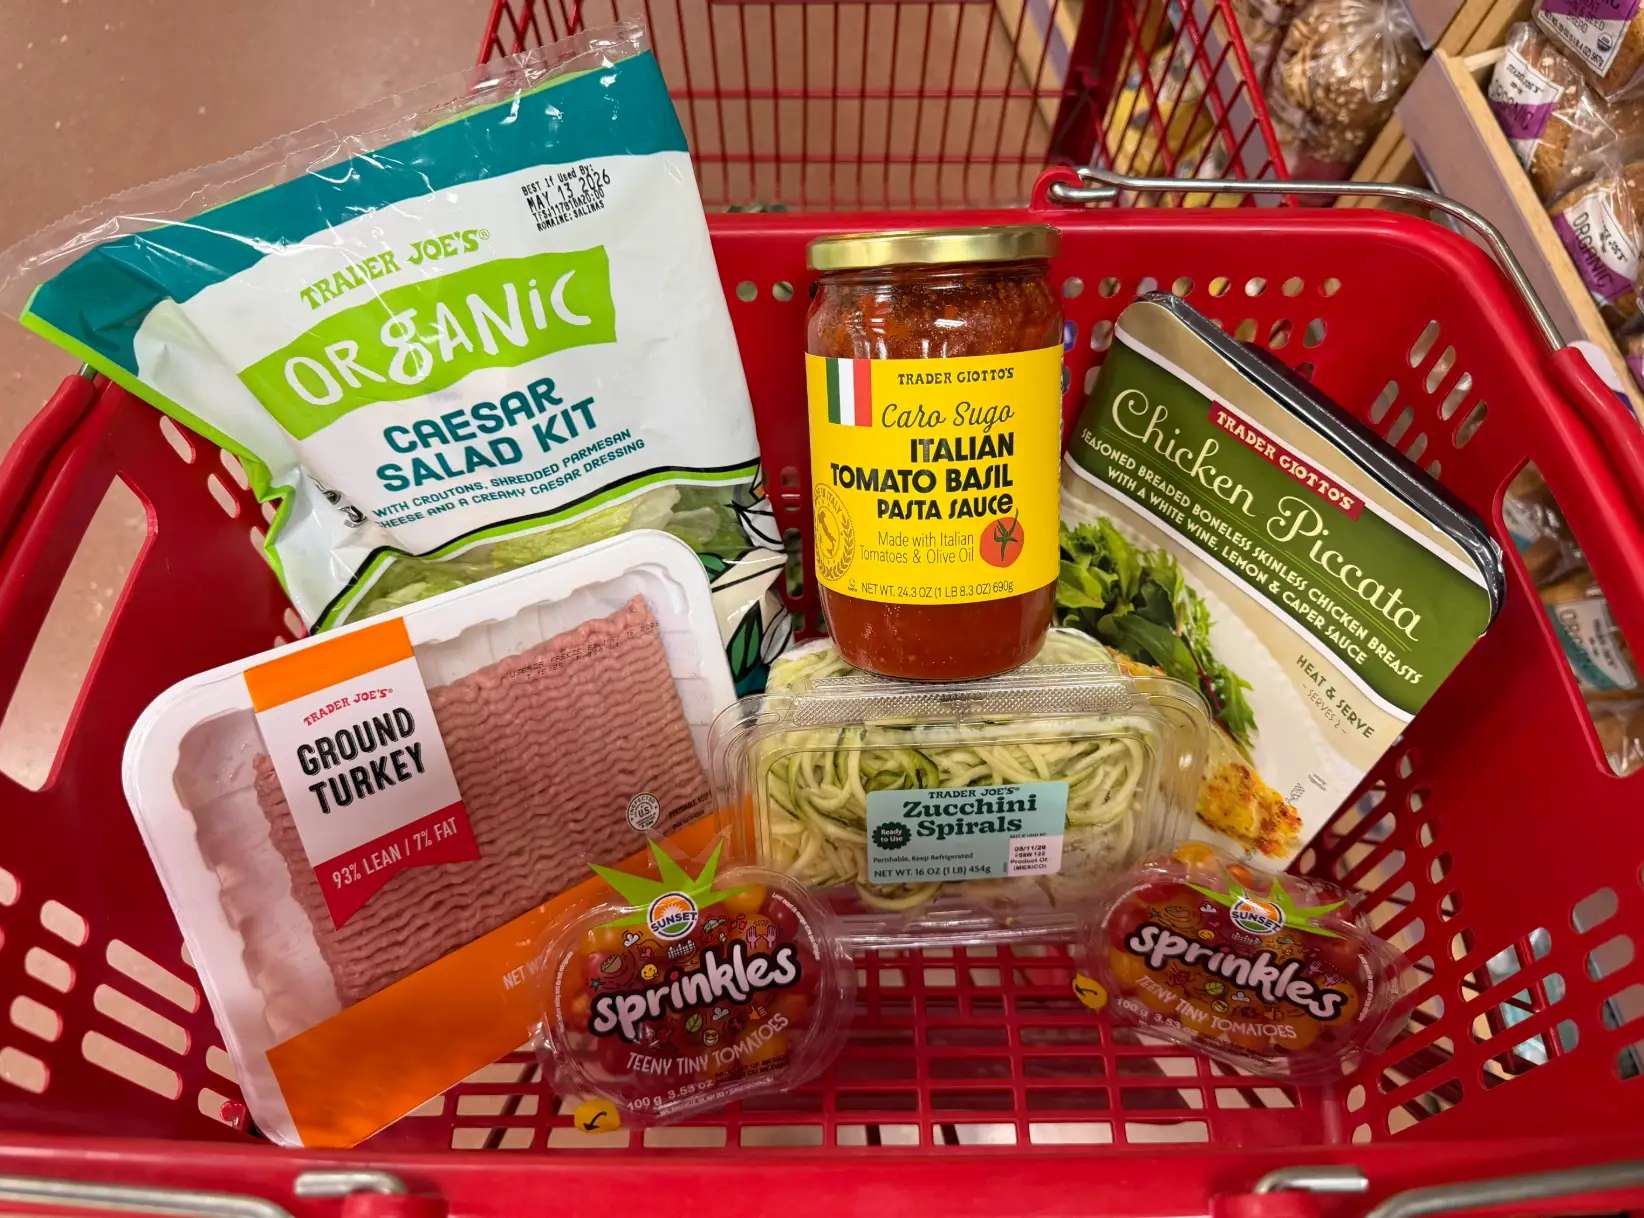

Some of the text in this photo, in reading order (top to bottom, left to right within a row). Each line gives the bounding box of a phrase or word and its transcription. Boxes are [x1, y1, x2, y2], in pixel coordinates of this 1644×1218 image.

[521, 164, 594, 196] BEST If Used By:
[526, 168, 611, 213] MAY 13 2026
[1573, 211, 1612, 288] ORGANIC
[299, 250, 402, 310] TRADER
[898, 367, 1014, 386] TRADER GIOTTO'S
[382, 376, 564, 454] CAESAR
[881, 401, 1015, 434] Caro Sugo
[376, 396, 599, 492] SALAD KIT
[910, 431, 1014, 463] ITALIAN
[1215, 409, 1356, 512] TRADER GIOTTO'S
[372, 500, 410, 518] WITH
[412, 480, 489, 507] CROUTONS,
[490, 462, 560, 488] SHREDDED
[562, 428, 632, 467] PARMESAN
[427, 502, 456, 518] AND
[460, 498, 470, 509] A
[472, 487, 527, 504] CREAMY
[530, 470, 582, 496] CAESAR
[584, 438, 646, 473] DRESSING
[830, 462, 1014, 494] TOMATO BASIL
[877, 498, 942, 520] PASTA
[1110, 388, 1422, 642] Chicken Piccata
[860, 544, 974, 564] Tomatoes & Olive Oil
[878, 530, 974, 547] Made with Italian
[1080, 427, 1424, 685] SEASONED BREADED BONELESS SKINLESS CHICKEN BREASTS
[1108, 466, 1369, 666] WITH A WHITE WINE, LEMON & CAPER SAUCE
[861, 582, 878, 596] NET
[879, 584, 896, 597] WT.
[897, 586, 917, 598] 24.3
[919, 587, 932, 598] OZ
[934, 586, 942, 600] (1
[944, 586, 958, 598] LB
[960, 585, 974, 597] 8.3
[976, 583, 991, 596] OZ)
[992, 580, 1014, 594] 690g
[303, 697, 350, 727] TRADER
[1296, 654, 1375, 739] HEAT & SERVE
[1306, 689, 1341, 729] SERVES 2
[296, 706, 416, 776] GROUND
[308, 742, 426, 814] TURKEY
[928, 789, 976, 799] TRADER
[902, 794, 1038, 818] Zucchini
[880, 828, 902, 836] Ready
[916, 816, 1022, 840] Spirals
[332, 862, 362, 890] 93%
[362, 842, 402, 876] LEAN
[412, 828, 434, 851] 7%
[434, 816, 458, 842] FAT
[874, 852, 974, 864] Perishable, Keep Refrigerated
[874, 869, 894, 878] NET
[895, 868, 913, 877] WT.
[916, 868, 924, 876] 16
[943, 866, 950, 876] (1
[952, 866, 966, 876] LB)
[968, 865, 991, 874] 454g
[650, 910, 698, 932] SUNSET
[1230, 910, 1283, 932] SUNSET
[502, 965, 526, 990] NET
[1128, 925, 1342, 1018] sprinkles
[593, 944, 797, 1040] sprinkles
[1135, 974, 1297, 1039] TEENY TINY TOMATOES
[1116, 998, 1138, 1012] 100
[1154, 1013, 1182, 1028] 3.53
[626, 1050, 672, 1077] TEENY
[676, 1054, 710, 1076] TINY
[712, 1012, 790, 1066] TOMATOES
[626, 1096, 651, 1112] 100
[653, 1095, 662, 1106] g
[668, 1083, 696, 1100] 3.53
[699, 1080, 714, 1090] oz
